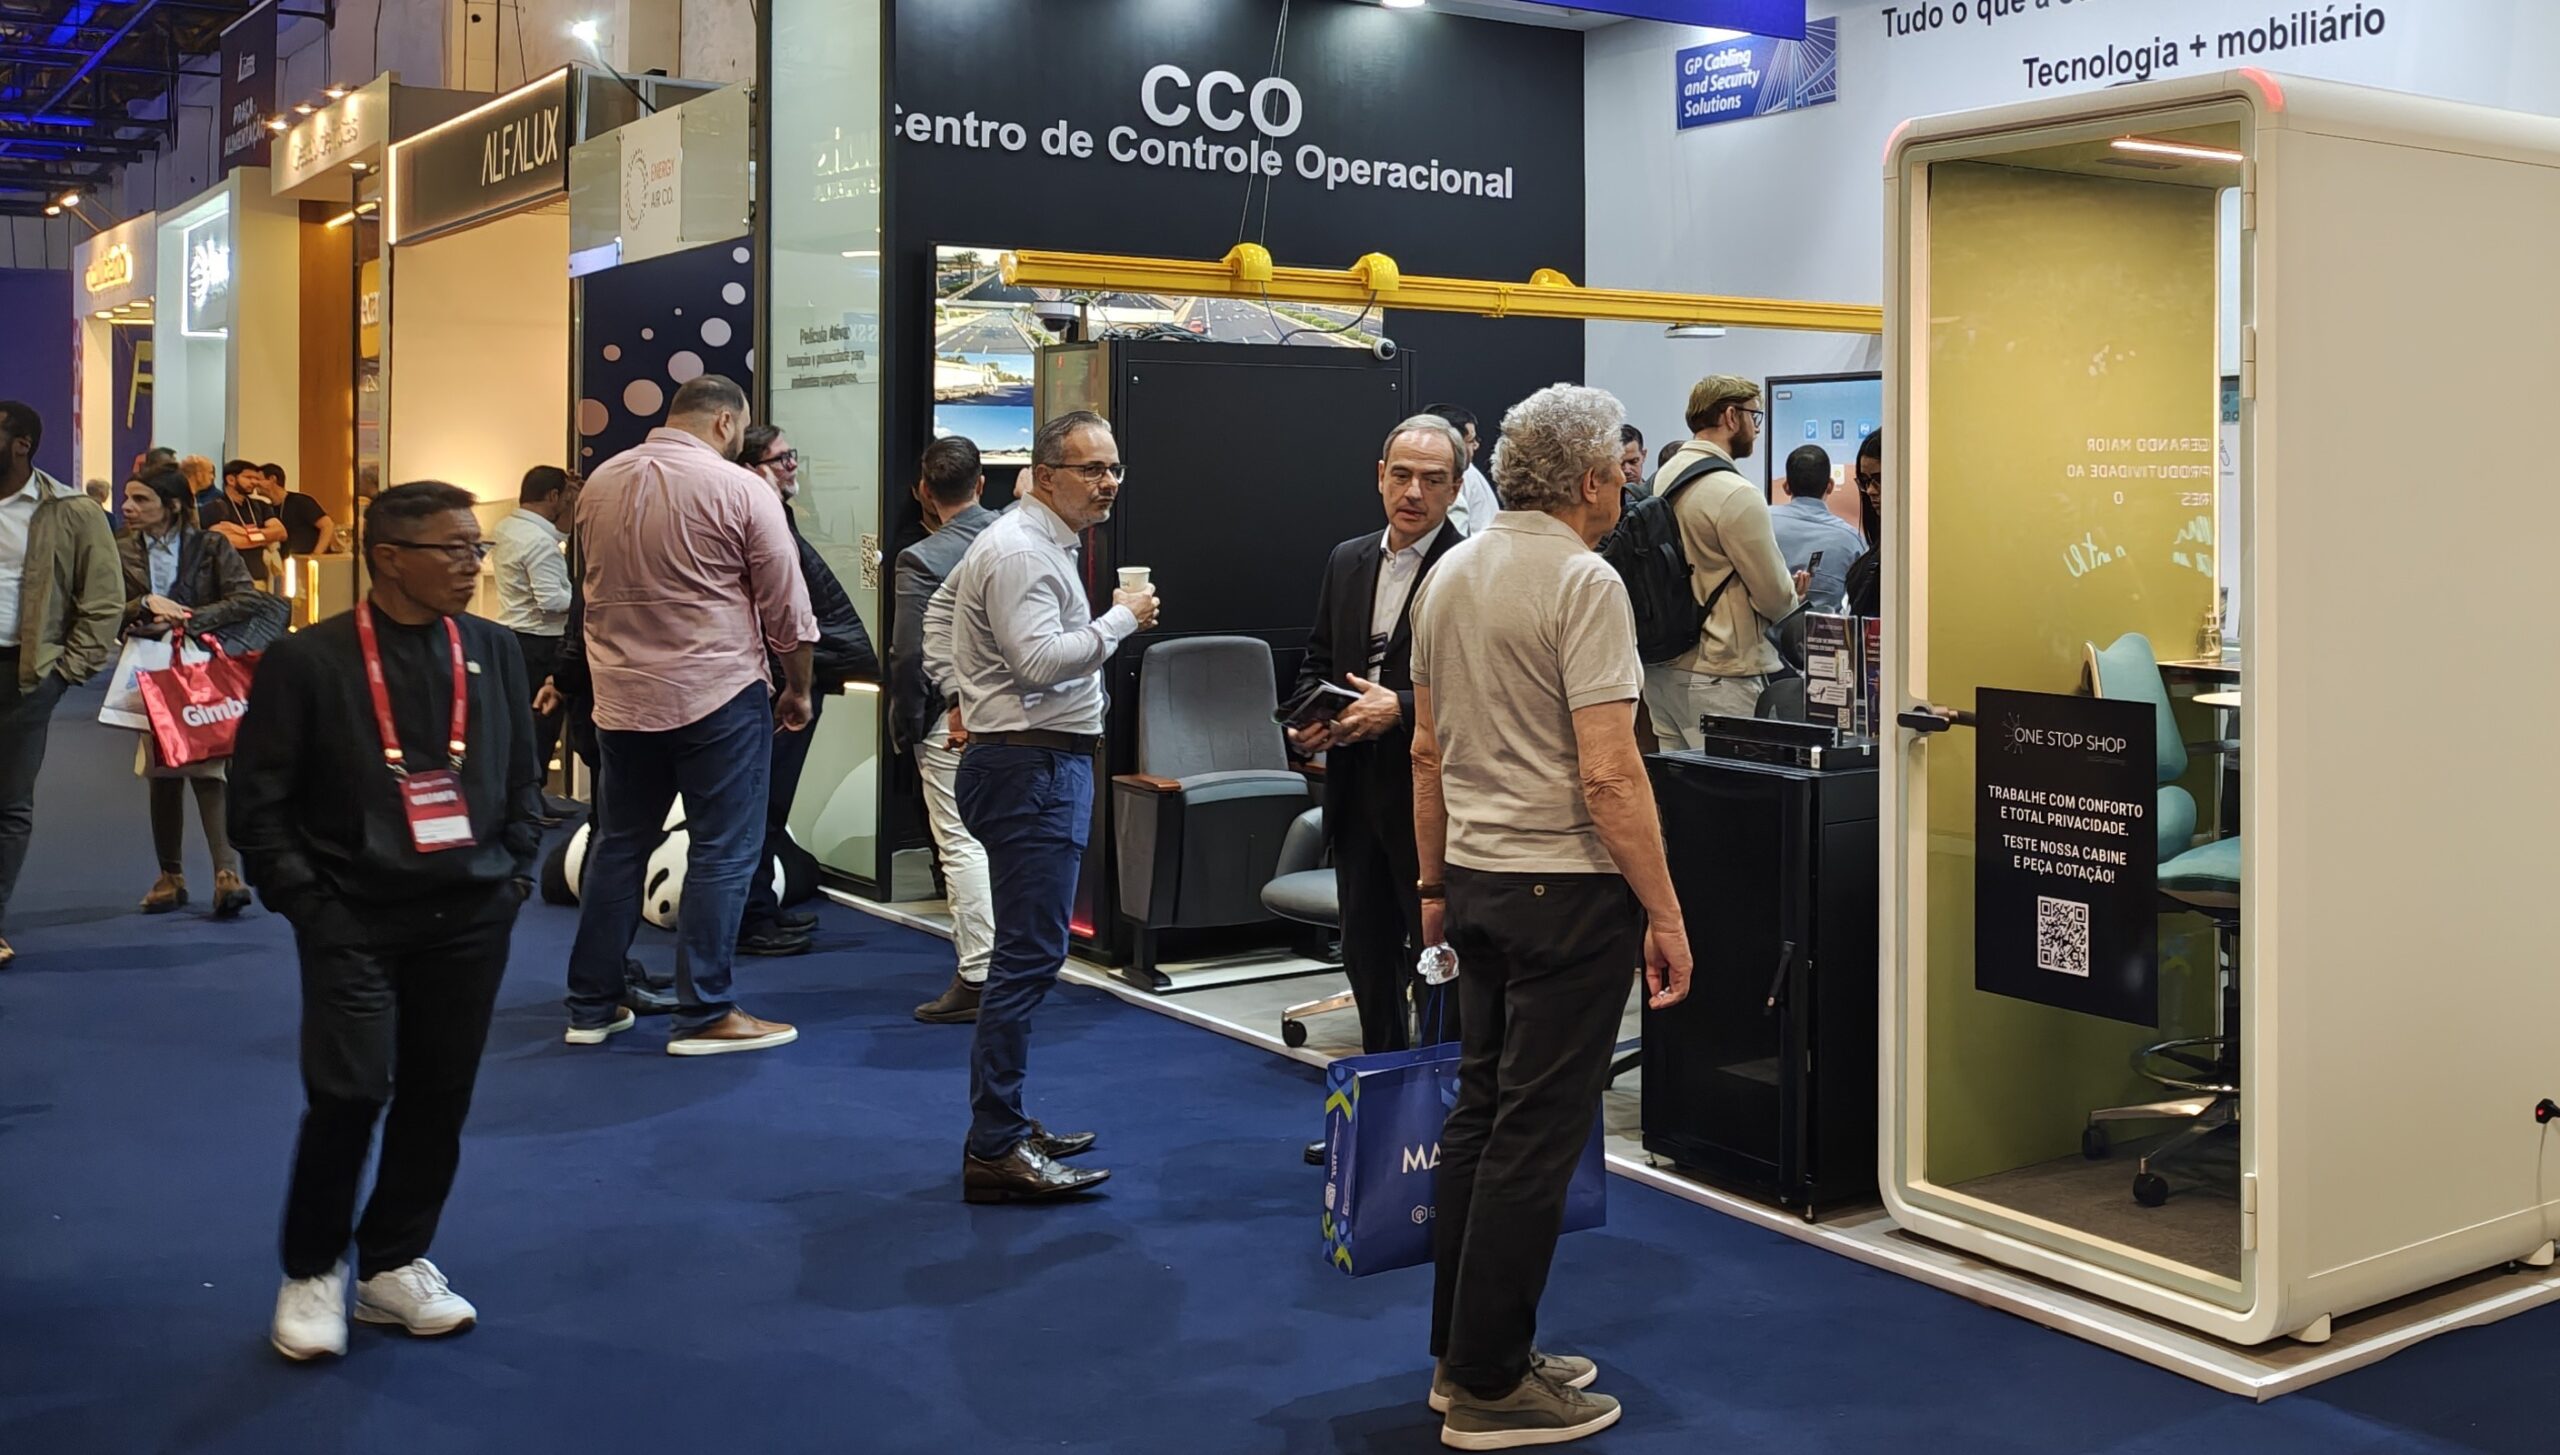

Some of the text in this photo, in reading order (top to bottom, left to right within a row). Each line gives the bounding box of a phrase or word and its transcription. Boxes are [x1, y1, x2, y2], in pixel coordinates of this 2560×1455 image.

[1882, 2, 1943, 38] Tudo
[1951, 1, 1968, 24] o
[1976, 0, 2025, 26] que
[1684, 48, 1752, 75] GP Cabling
[2022, 3, 2386, 89] Tecnologia + mobiliário
[1684, 67, 1760, 96] and Security
[1141, 64, 1303, 138] CCO
[1684, 94, 1742, 118] Solutions
[481, 105, 559, 187] ALFALUX
[895, 103, 1513, 199] entro de Controle Operacional
[650, 157, 676, 182] ENERGY
[2014, 727, 2127, 754] ONE STOP SHOP
[1988, 784, 2143, 818] TRABALHE COM CONFORTO
[2000, 805, 2129, 836] E TOTAL PRIVACIDADE.
[2002, 834, 2127, 866] TESTE NOSSA CABINE
[2013, 855, 2116, 884] E PEÇA COTAÇÃO!
